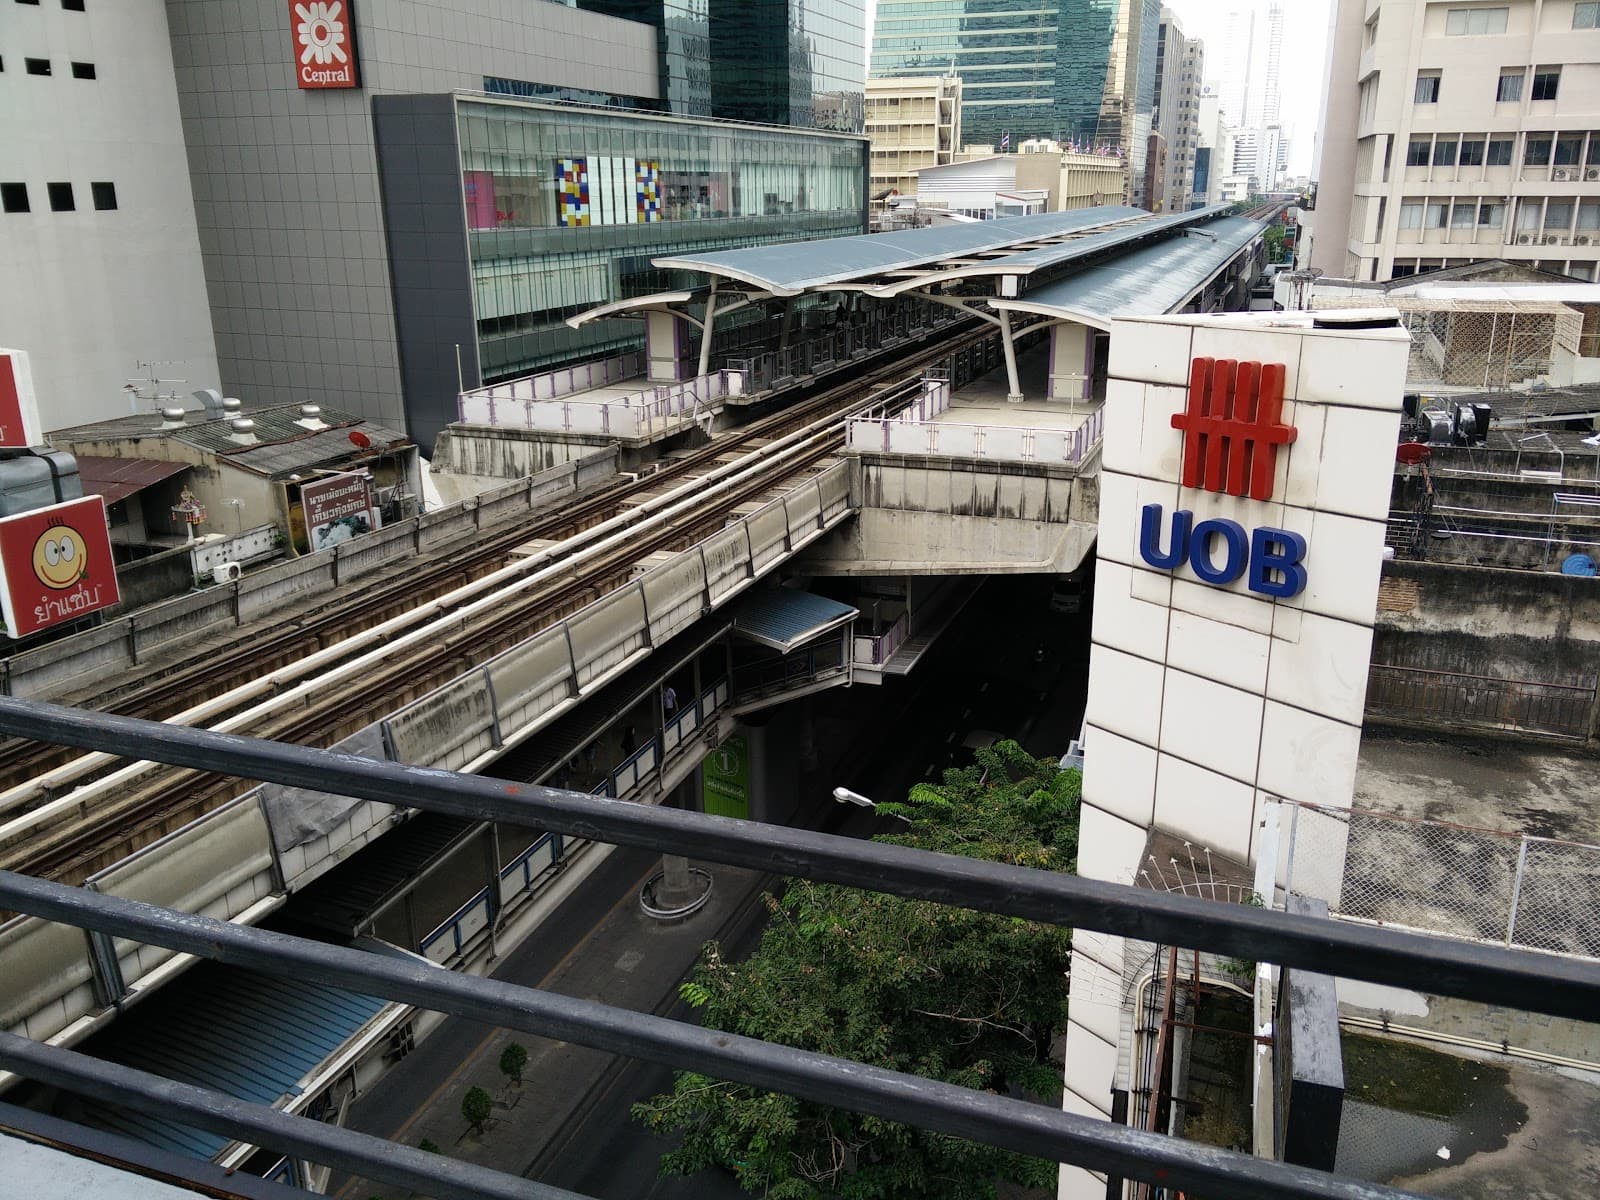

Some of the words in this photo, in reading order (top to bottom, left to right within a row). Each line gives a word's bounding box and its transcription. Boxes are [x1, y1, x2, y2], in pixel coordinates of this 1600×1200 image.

[301, 65, 350, 85] Central
[1139, 503, 1308, 598] UOB
[34, 583, 100, 625] ยำแซ่บ
